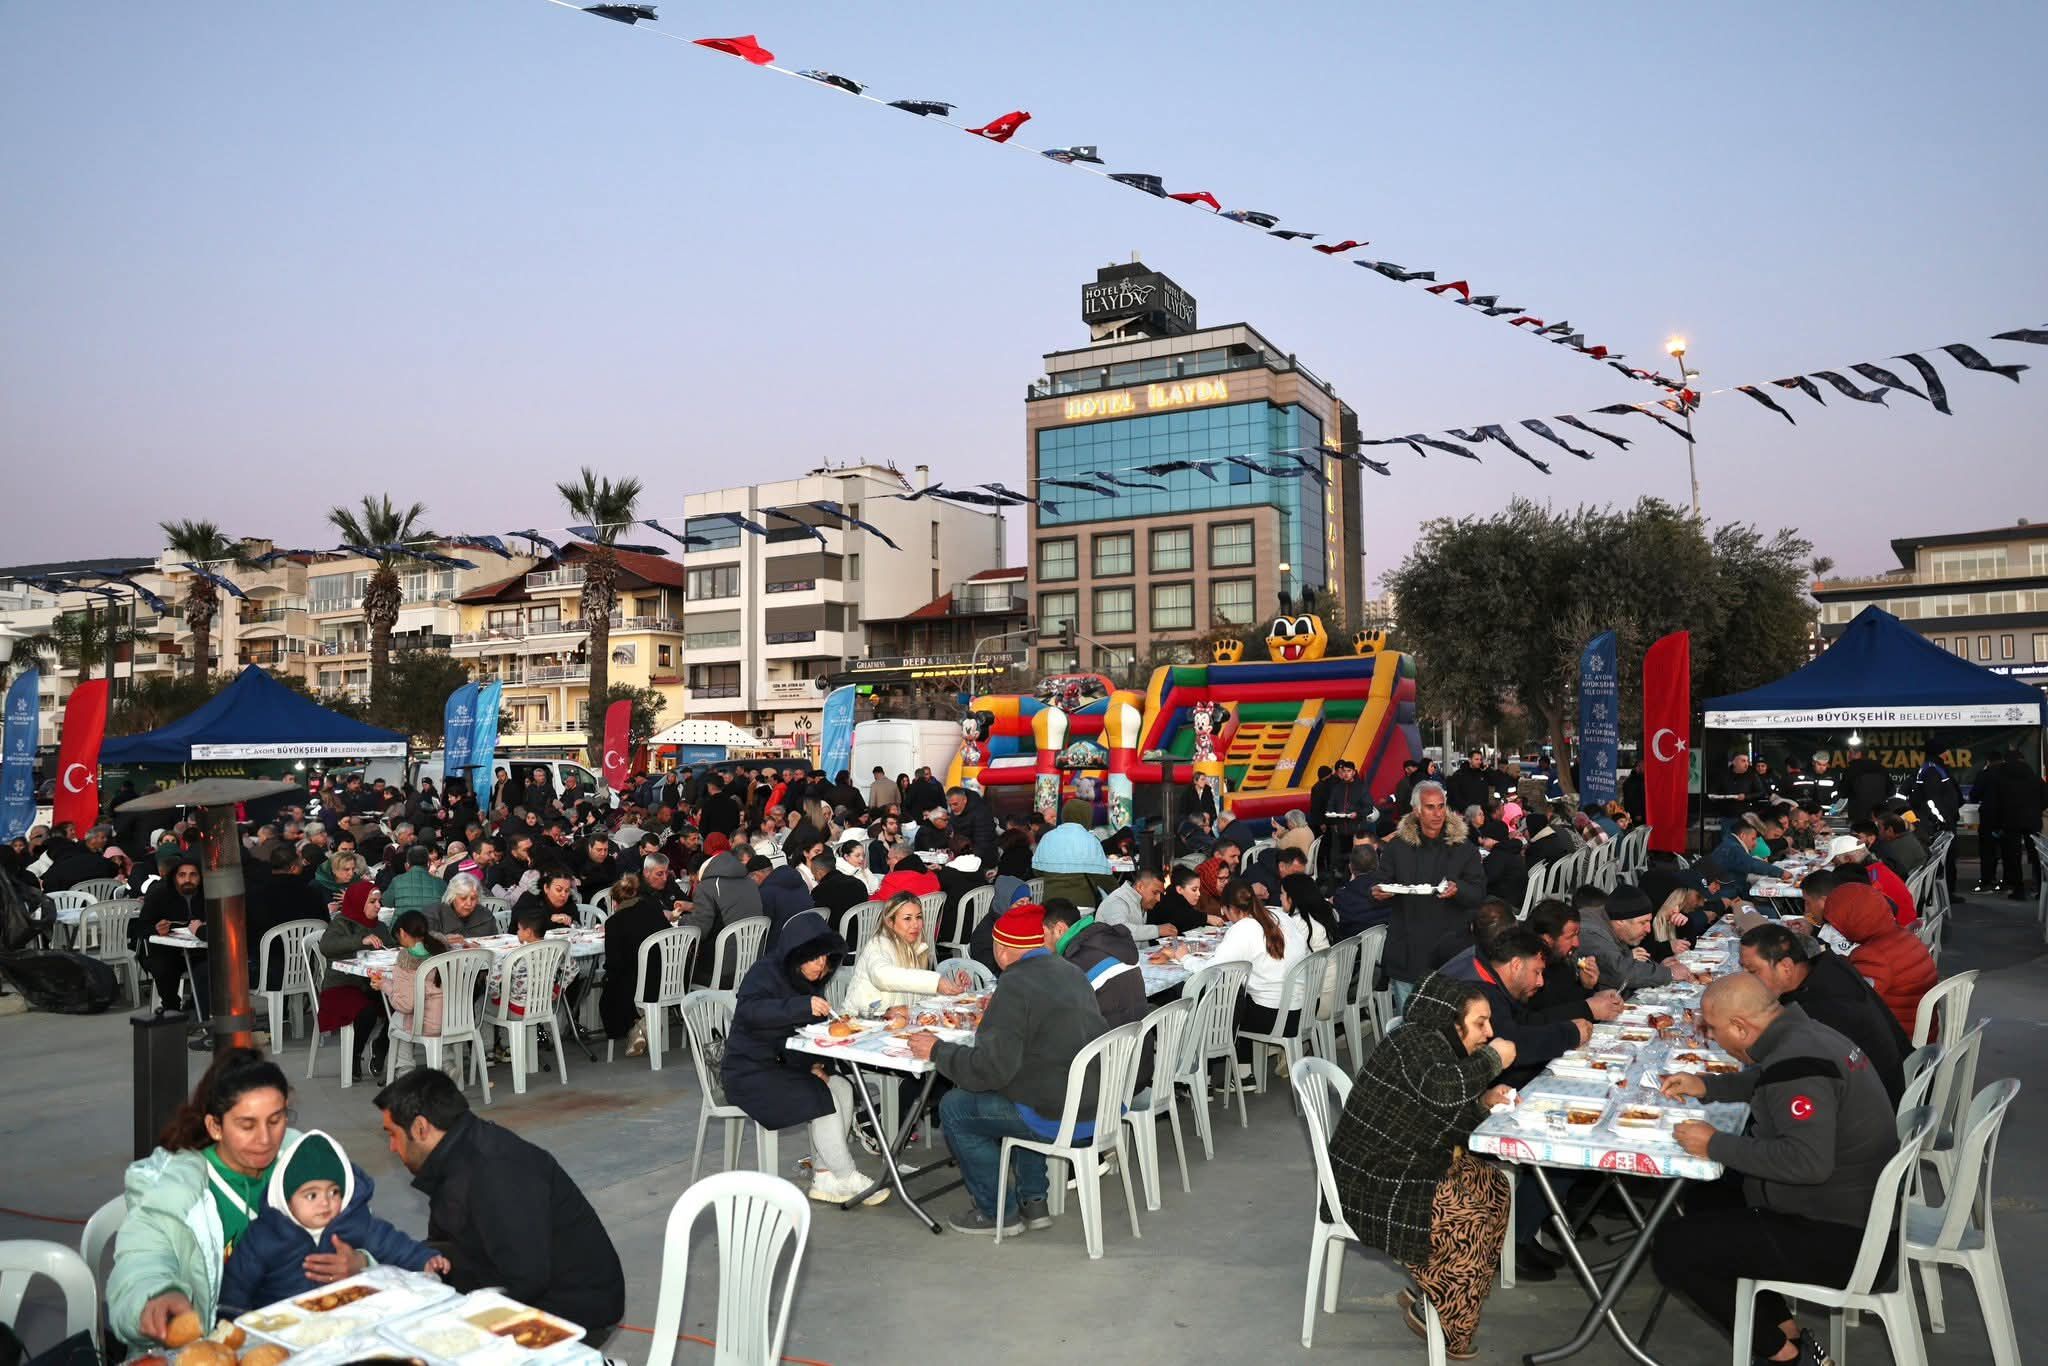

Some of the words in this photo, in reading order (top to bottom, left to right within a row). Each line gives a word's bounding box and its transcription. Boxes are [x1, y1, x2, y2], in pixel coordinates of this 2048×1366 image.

[1086, 286, 1118, 299] HOTEL
[1065, 391, 1136, 420] HOTEL
[903, 657, 926, 667] DEEP
[1817, 712, 1896, 723] BÜYÜKŞEHİR
[1899, 711, 1961, 721] BELEDİYESİ
[277, 745, 328, 755] BÜYÜKŞEHİR
